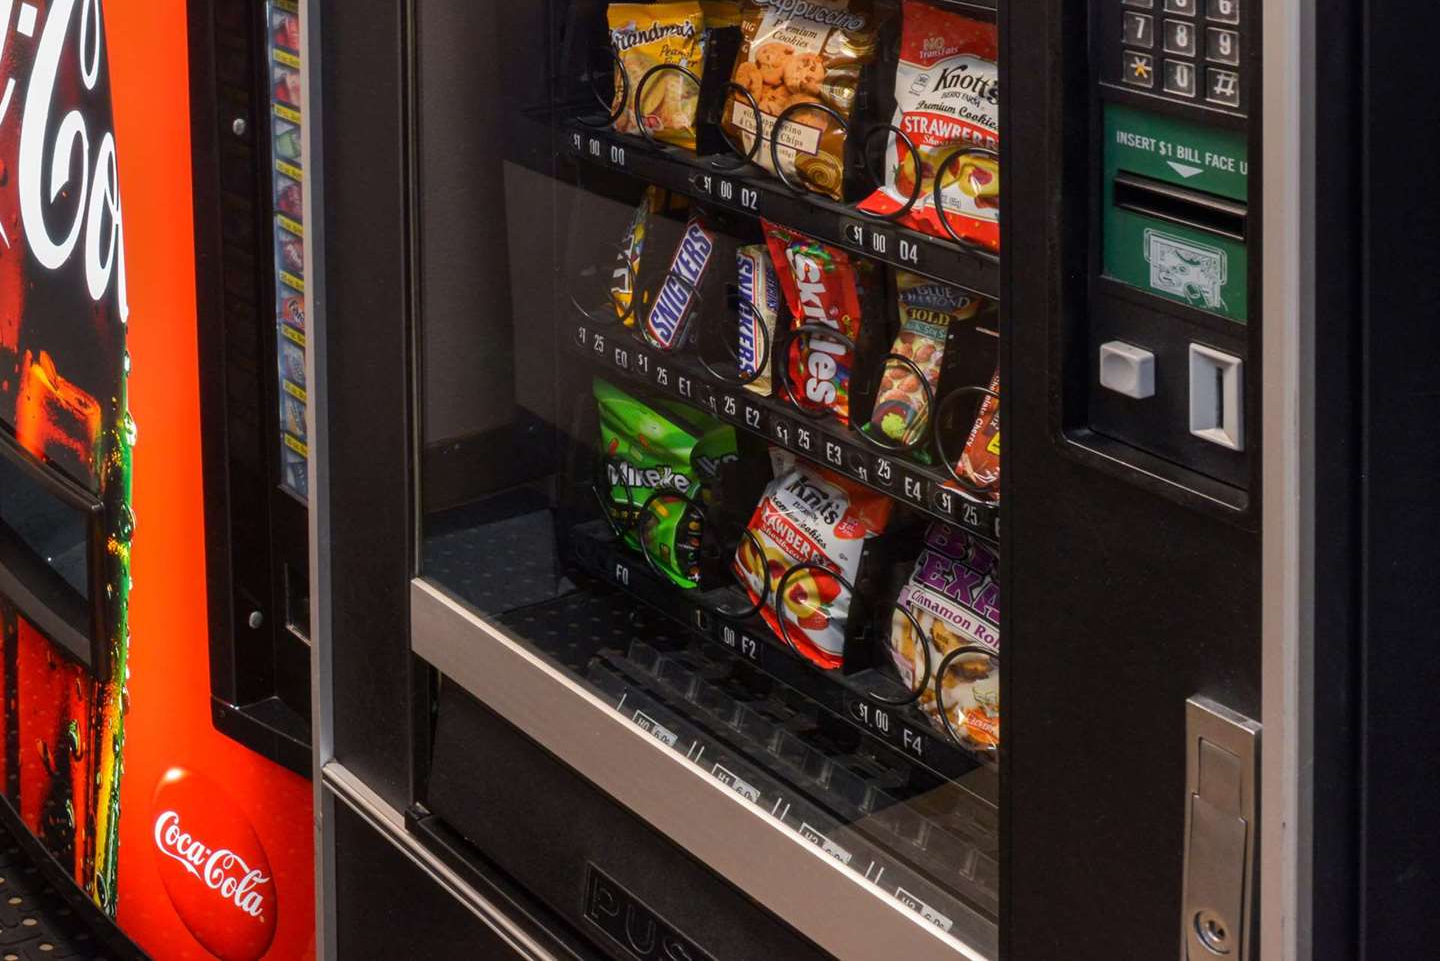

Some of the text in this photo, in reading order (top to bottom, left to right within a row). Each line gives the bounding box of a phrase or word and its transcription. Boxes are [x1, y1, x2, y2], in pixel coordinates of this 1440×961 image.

[610, 20, 696, 51] randma's
[772, 30, 809, 48] Cookies
[1136, 17, 1145, 39] 7
[1176, 25, 1188, 47] 8
[1219, 33, 1231, 55] 9
[1214, 73, 1237, 96] #
[915, 100, 956, 115] Premium
[589, 139, 600, 156] 00
[780, 132, 804, 148] Chips
[1116, 130, 1248, 175] INSERT $1 BILL FACE U
[704, 175, 757, 210] $1 00 D2
[854, 226, 918, 264] $1 00 D4
[650, 224, 712, 343] SNICKERS
[916, 286, 952, 298] BLUE
[594, 334, 604, 353] 25
[615, 348, 627, 368] E0
[638, 353, 691, 397] $1 25 E1
[724, 396, 736, 416] 25
[746, 407, 760, 429] E2
[776, 426, 842, 466] $1 25 E3
[877, 458, 891, 480] 25
[904, 476, 921, 502] E4
[942, 492, 978, 526] $1 25
[616, 564, 629, 585] F0
[911, 589, 1000, 648] Cinnamon Rol
[742, 636, 756, 659] F2
[904, 728, 921, 755] F4
[154, 810, 270, 917] Coca-Cola
